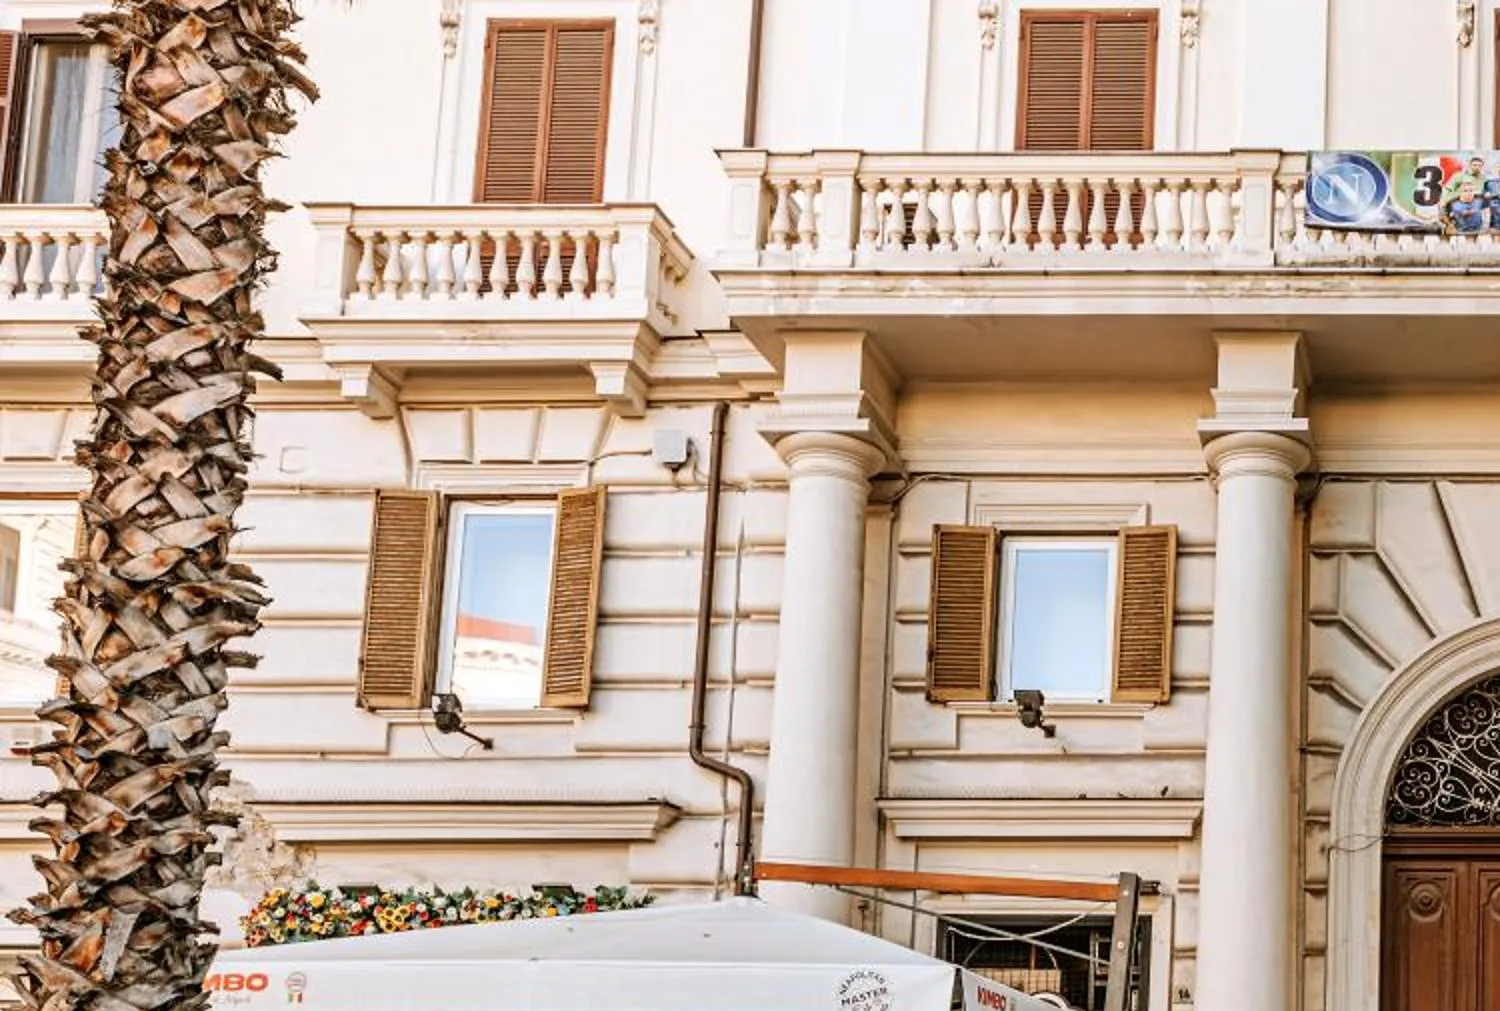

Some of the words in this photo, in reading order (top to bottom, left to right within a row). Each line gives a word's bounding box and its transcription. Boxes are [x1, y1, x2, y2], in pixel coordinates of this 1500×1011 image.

[1414, 165, 1443, 206] 3
[202, 973, 269, 992] MBO
[841, 987, 888, 1005] MASTER
